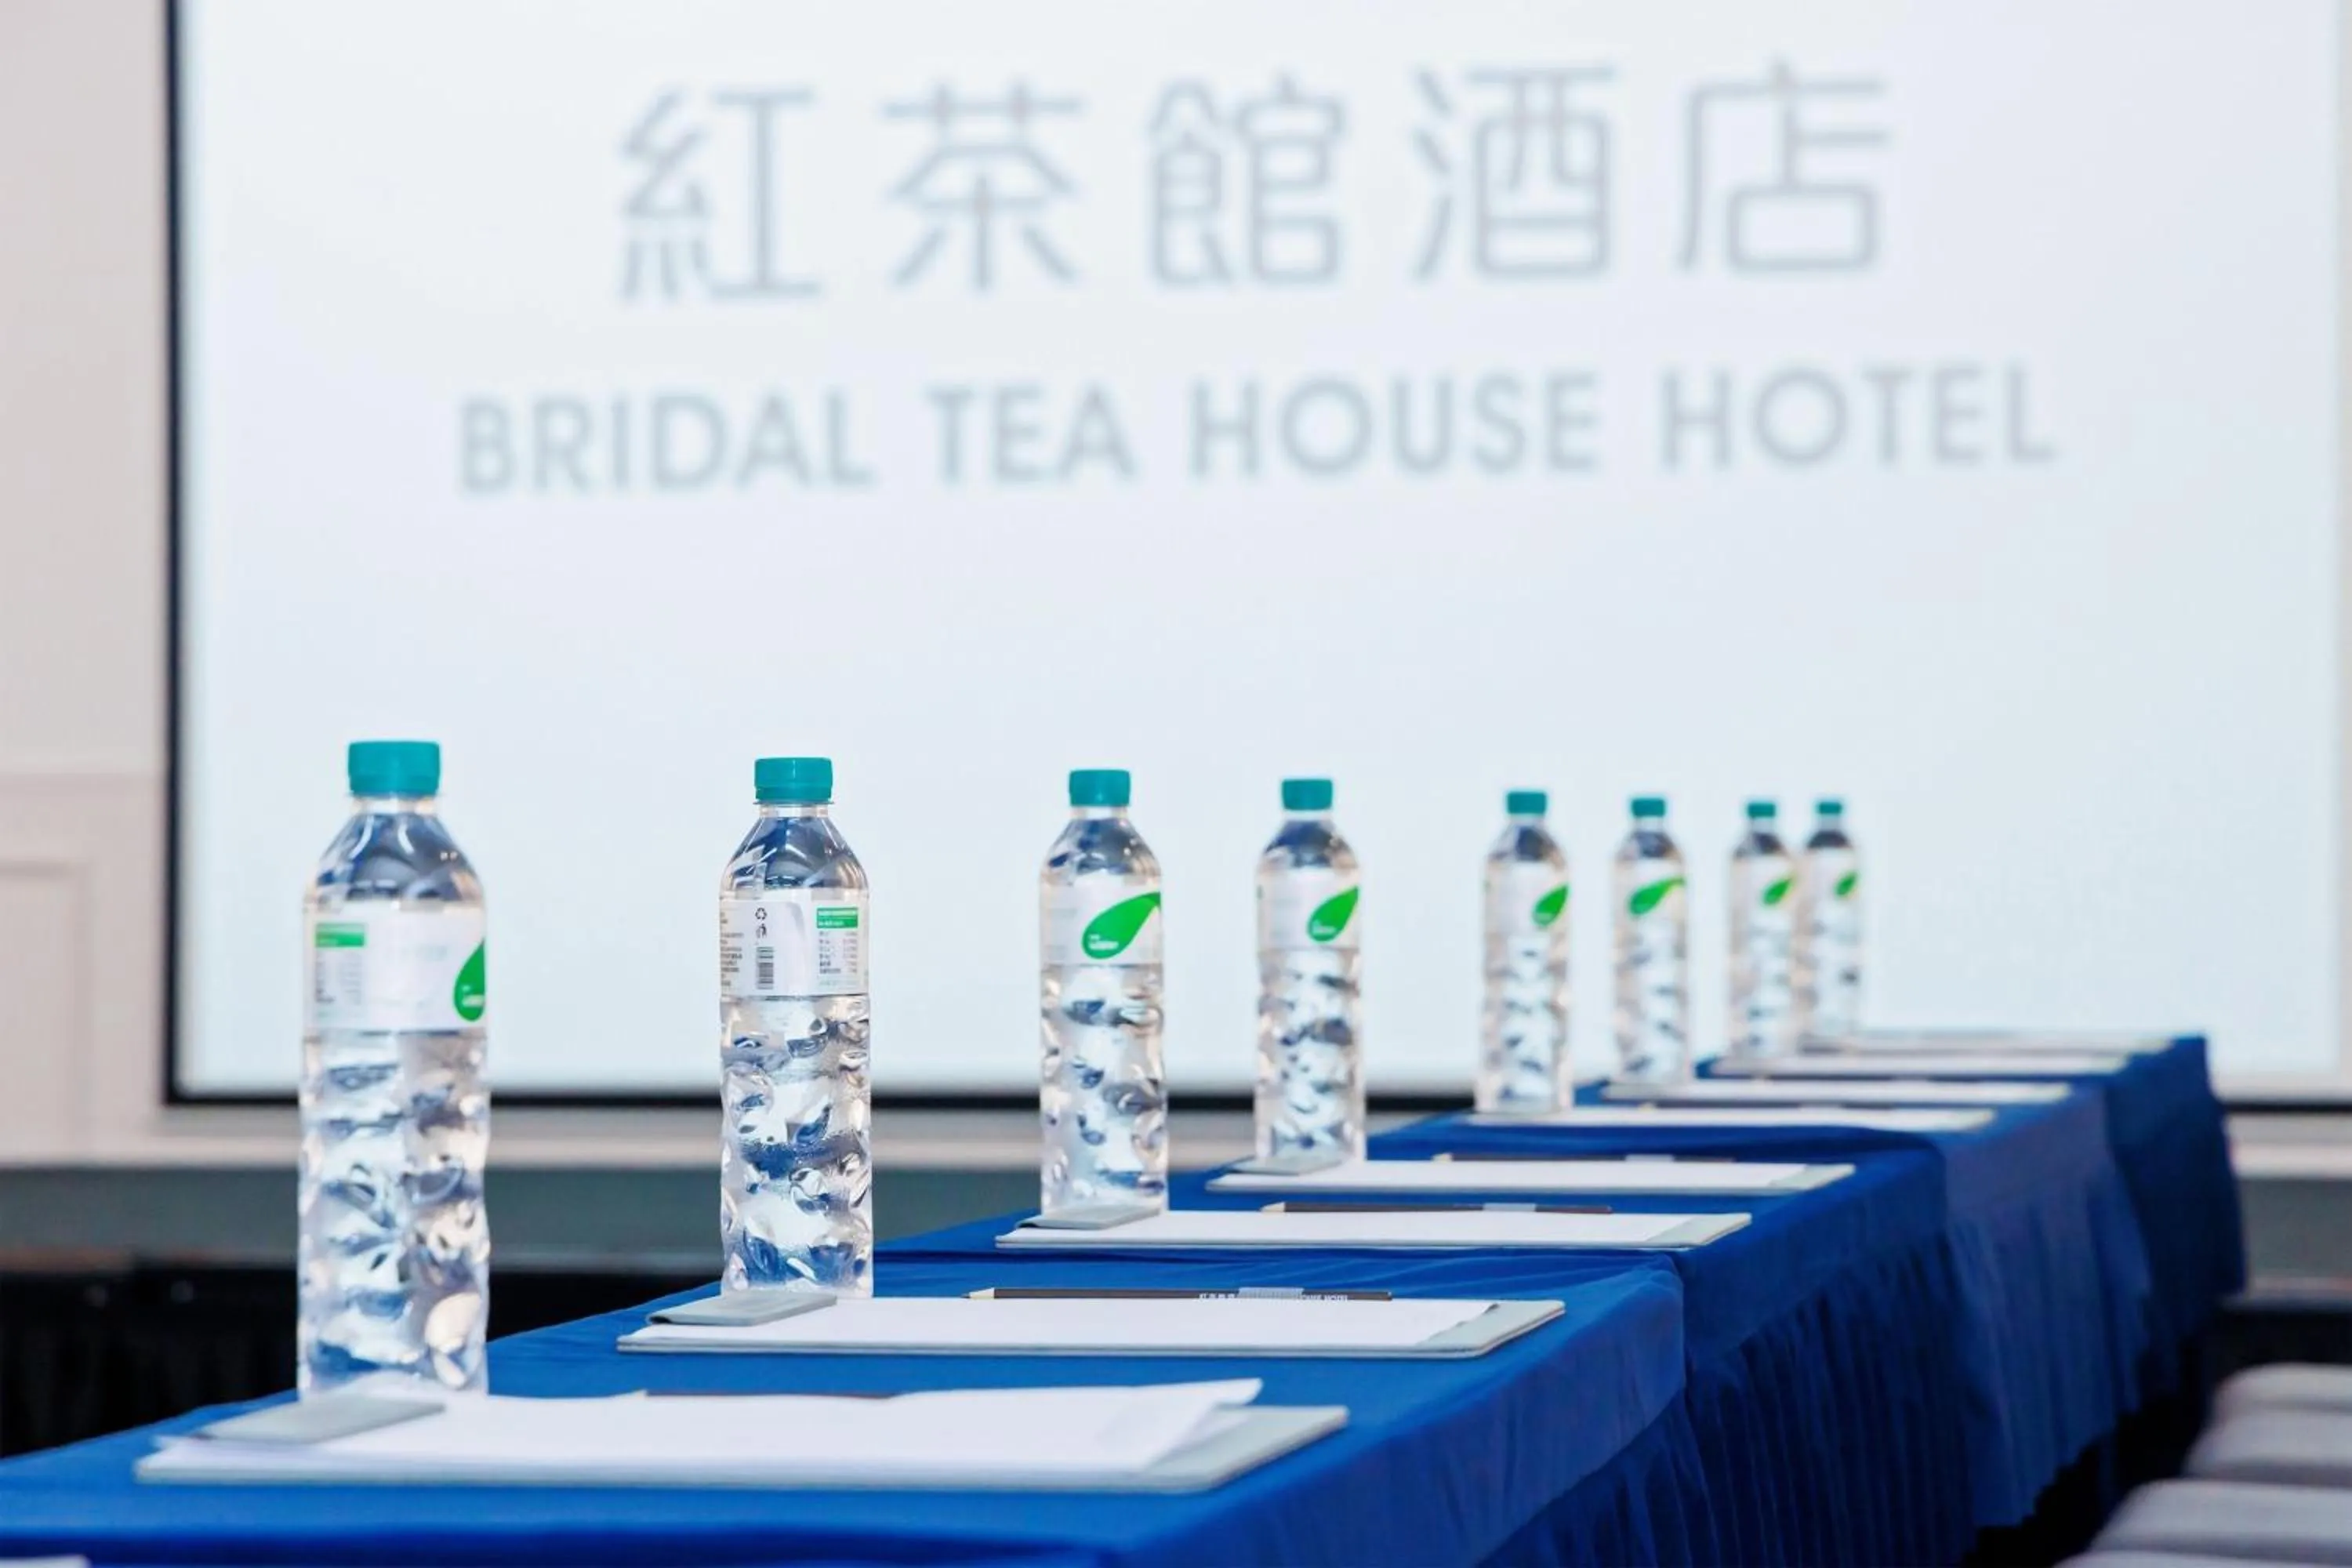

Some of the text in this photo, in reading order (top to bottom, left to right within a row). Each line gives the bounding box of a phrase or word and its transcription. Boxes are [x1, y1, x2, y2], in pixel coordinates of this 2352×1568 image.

[619, 58, 1889, 302] 紅茶館酒店
[459, 363, 2055, 495] BRIDAL TEA HOUSE HOTEL
